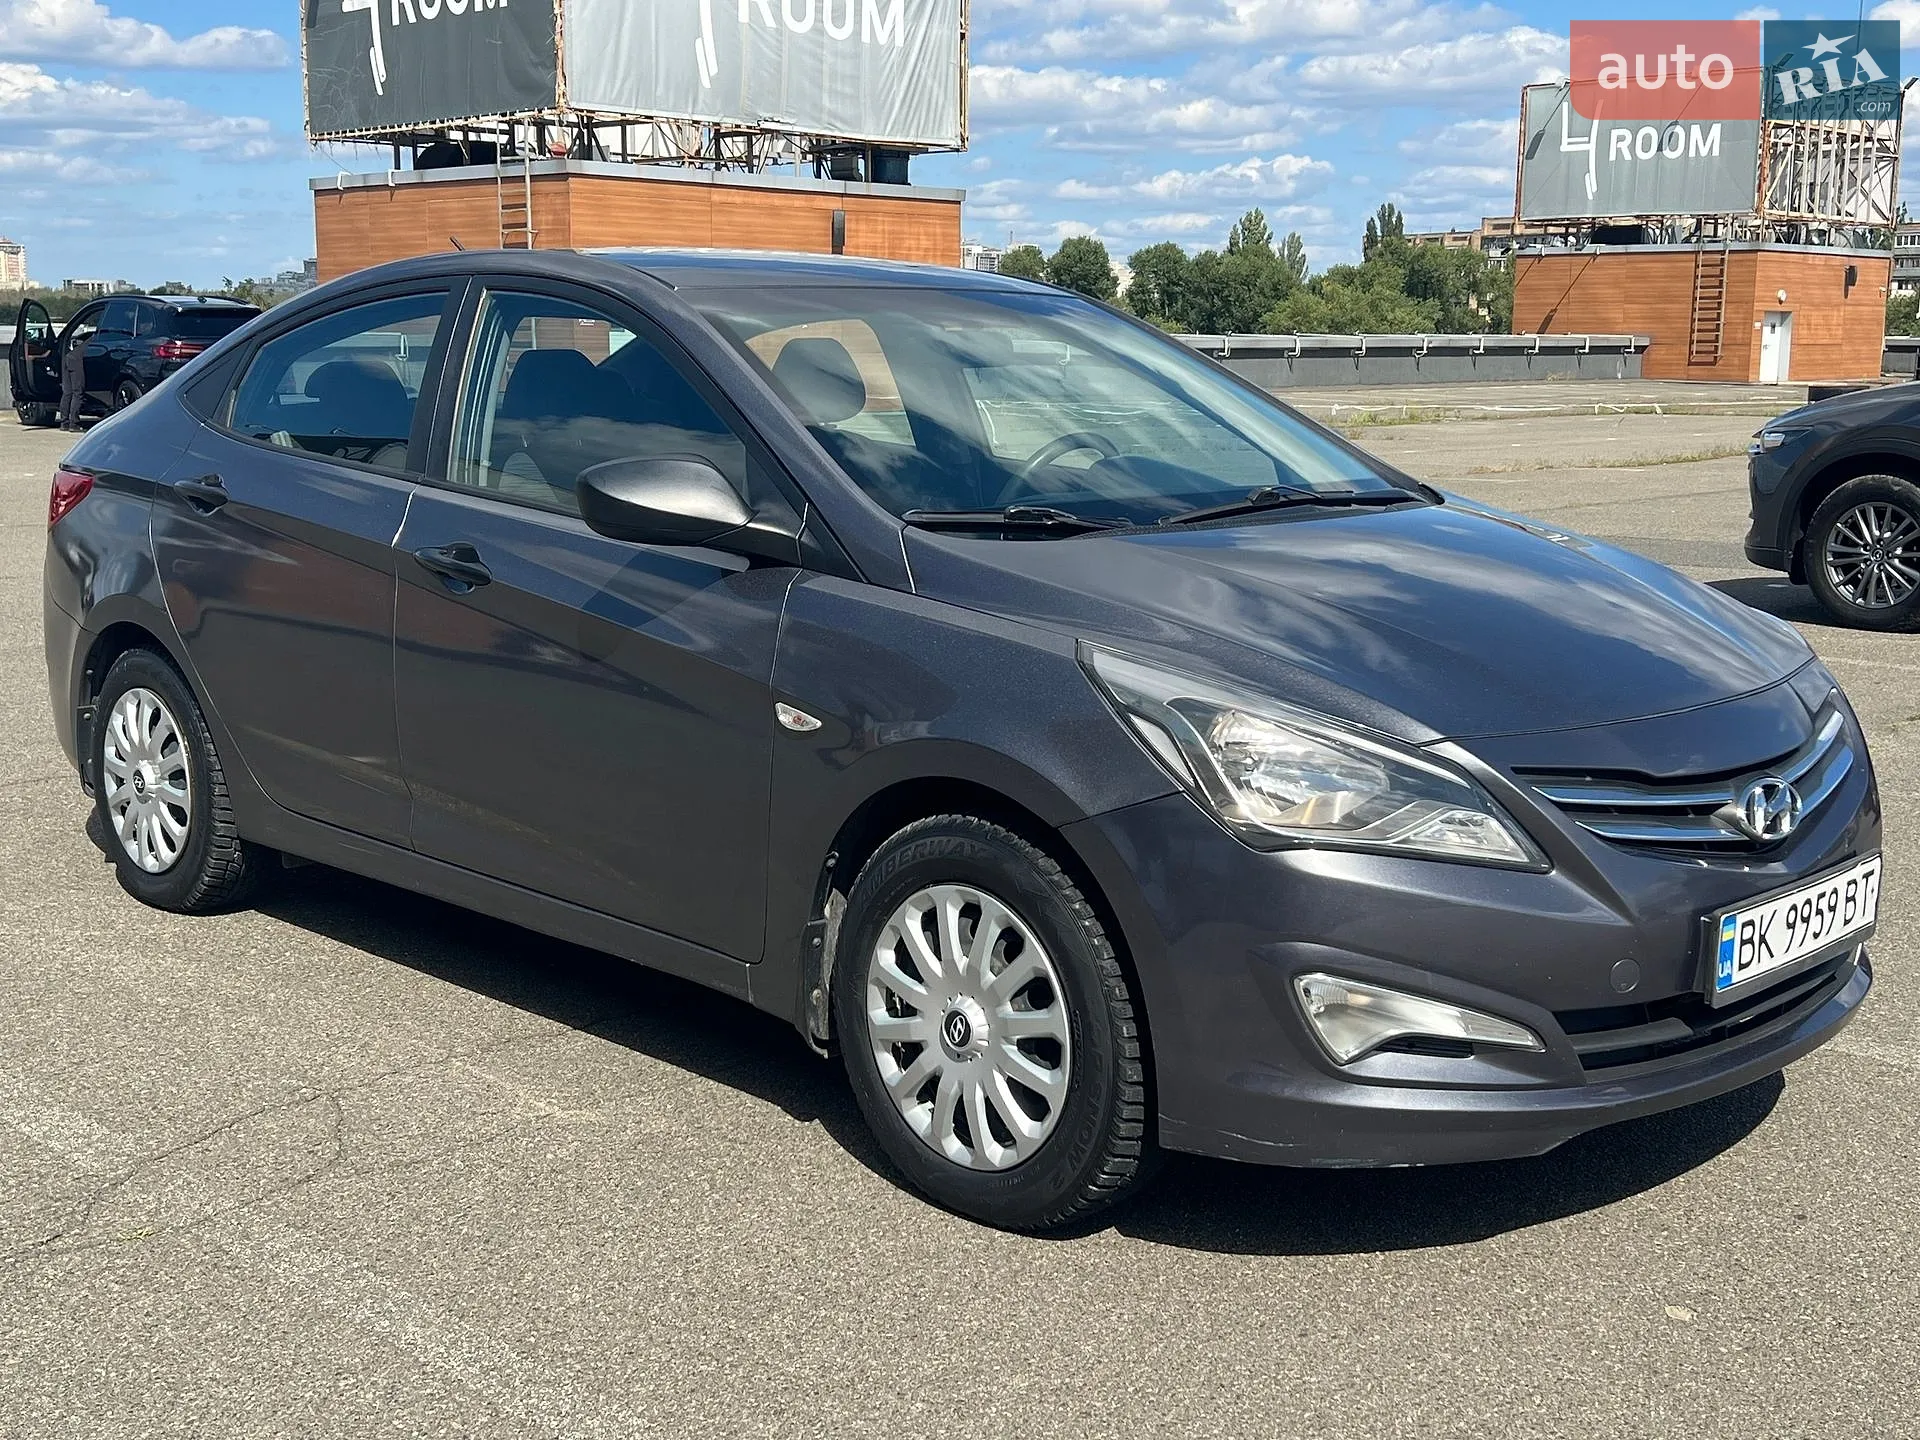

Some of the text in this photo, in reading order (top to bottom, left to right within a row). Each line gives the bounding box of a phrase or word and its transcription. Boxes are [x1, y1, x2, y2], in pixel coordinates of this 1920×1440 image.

[1608, 123, 1722, 162] ROOM
[1738, 868, 1875, 972] BK 9959 BT
[1718, 960, 1733, 978] UA
